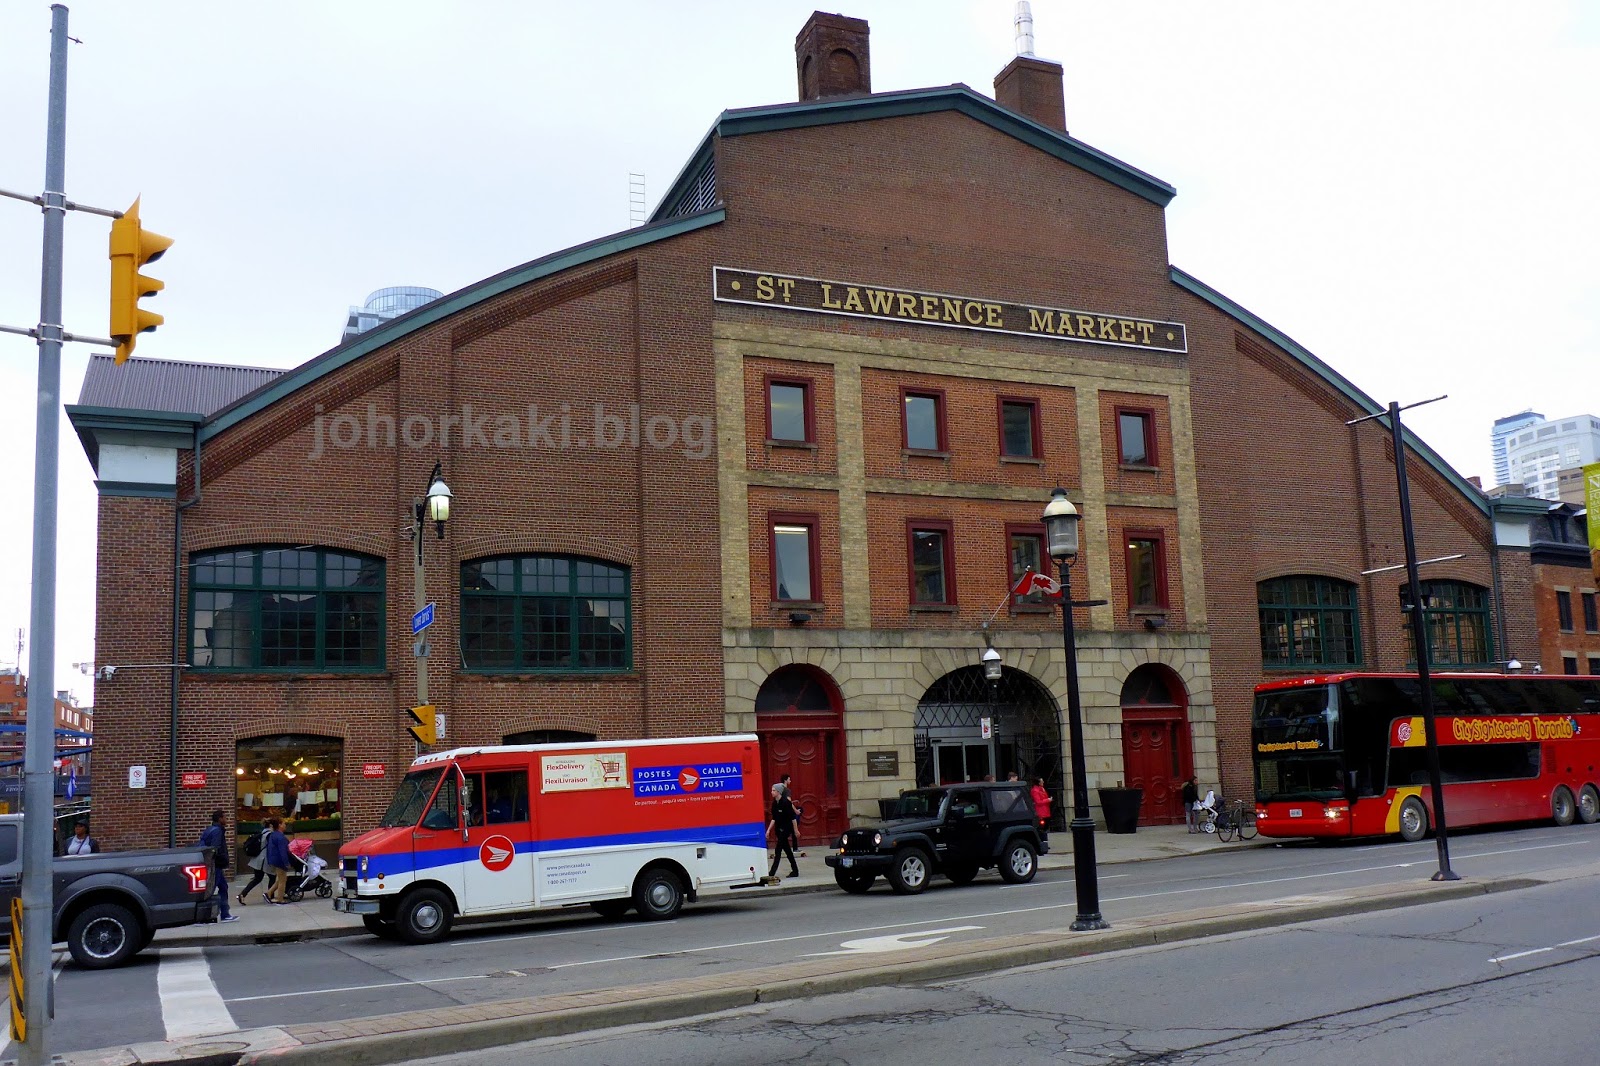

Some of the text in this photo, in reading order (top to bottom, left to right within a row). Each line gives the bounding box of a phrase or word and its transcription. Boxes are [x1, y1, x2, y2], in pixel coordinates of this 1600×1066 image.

[821, 284, 1003, 328] LAWRENCE
[1028, 308, 1154, 344] MARKET
[1452, 716, 1573, 742] CitySightseeing Toronto
[546, 763, 585, 771] FlexDelivery
[638, 766, 738, 779] POSTES CANADA
[545, 777, 588, 785] FlexiLivraison
[639, 780, 725, 793] CANADA POST
